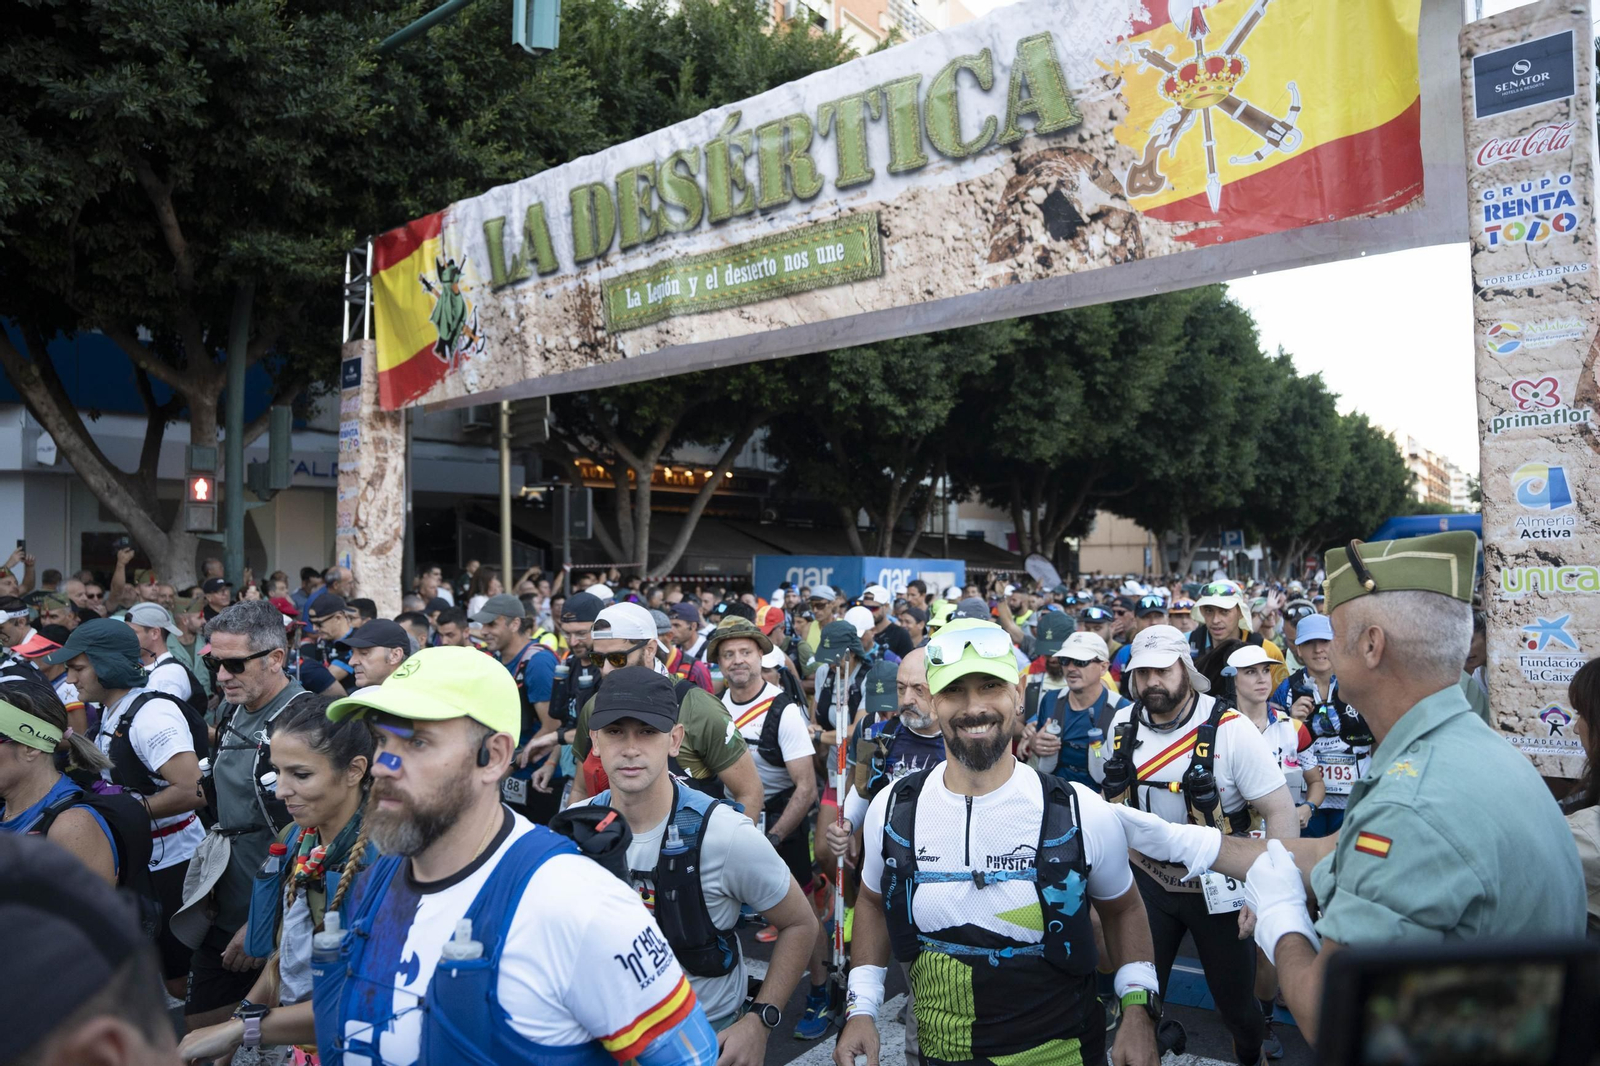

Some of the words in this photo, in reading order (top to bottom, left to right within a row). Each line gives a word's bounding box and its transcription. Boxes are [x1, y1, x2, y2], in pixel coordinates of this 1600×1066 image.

[1495, 72, 1551, 93] SENATOR
[1477, 121, 1576, 166] Coca-Cola
[482, 201, 560, 292] LA
[569, 30, 1085, 265] DESÉRTICA
[1484, 174, 1572, 200] GRUPO
[1484, 189, 1576, 222] RENTA
[1485, 212, 1577, 245] TODO
[626, 287, 642, 309] La
[647, 275, 680, 305] Legión
[688, 276, 698, 297] y
[706, 266, 718, 290] el
[725, 257, 777, 285] desierto
[784, 250, 809, 273] nos
[815, 242, 845, 265] une
[1484, 263, 1588, 286] TORRECARDENAS
[1493, 409, 1590, 434] primaflor
[1516, 515, 1575, 527] Almería
[1520, 528, 1571, 539] Activa
[1225, 531, 1238, 546] P
[786, 566, 833, 591] gar
